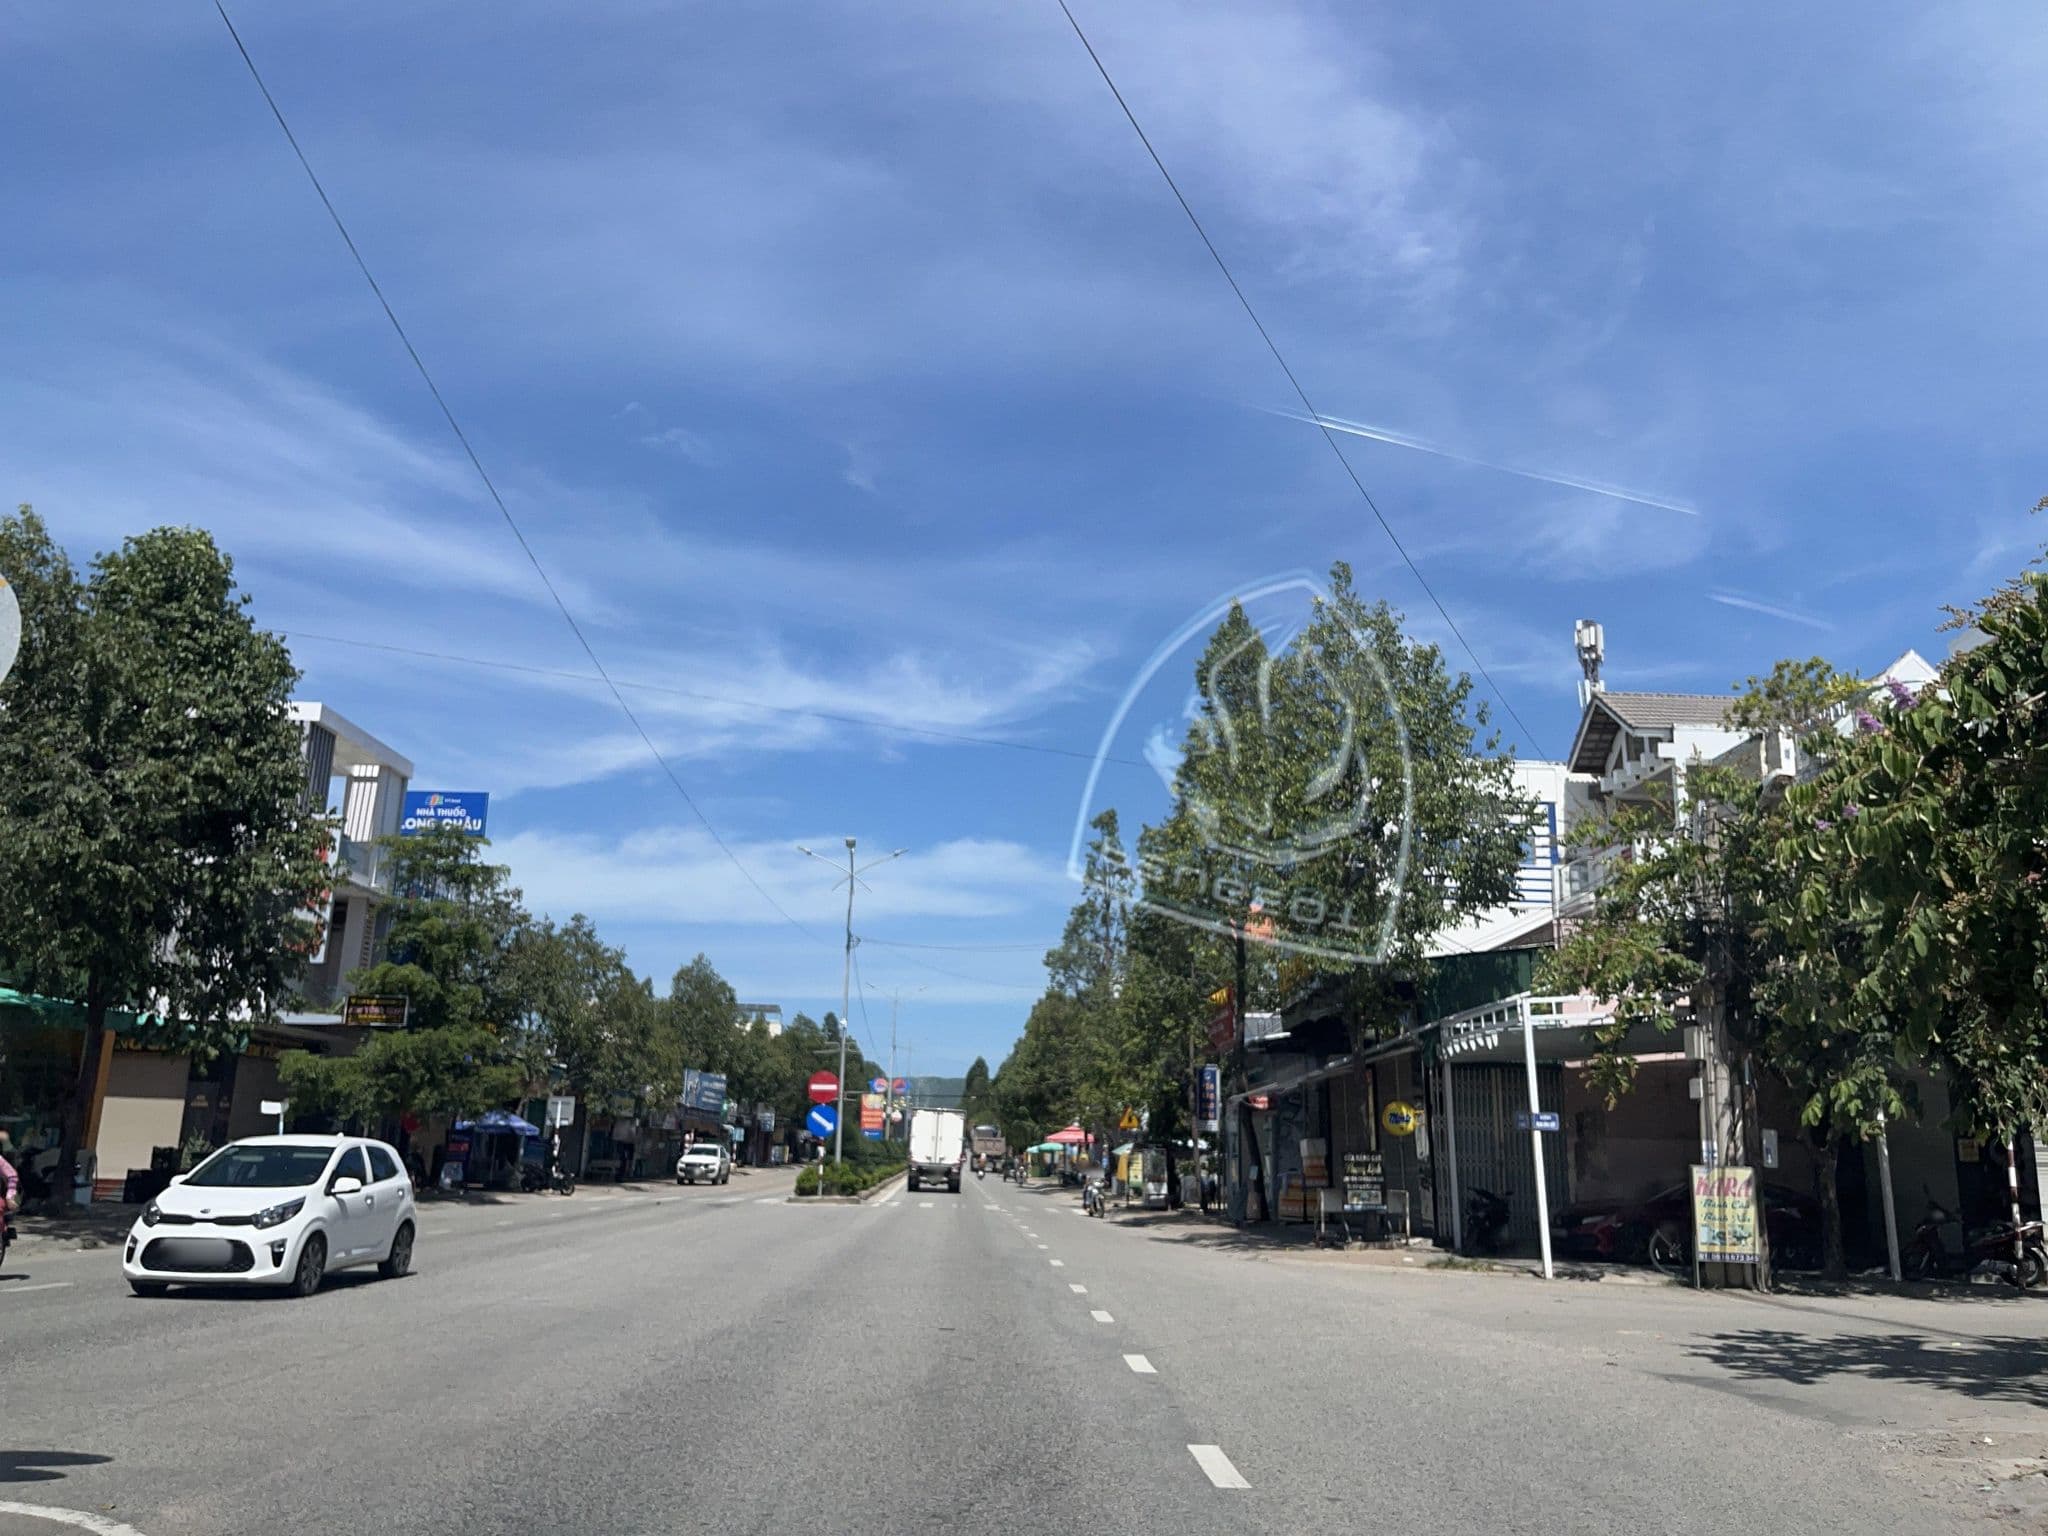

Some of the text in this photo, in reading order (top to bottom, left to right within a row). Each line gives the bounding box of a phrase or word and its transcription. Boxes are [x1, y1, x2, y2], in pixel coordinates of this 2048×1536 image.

[416, 805, 467, 817] NHÀ THUỐC
[401, 817, 437, 830] ONG
